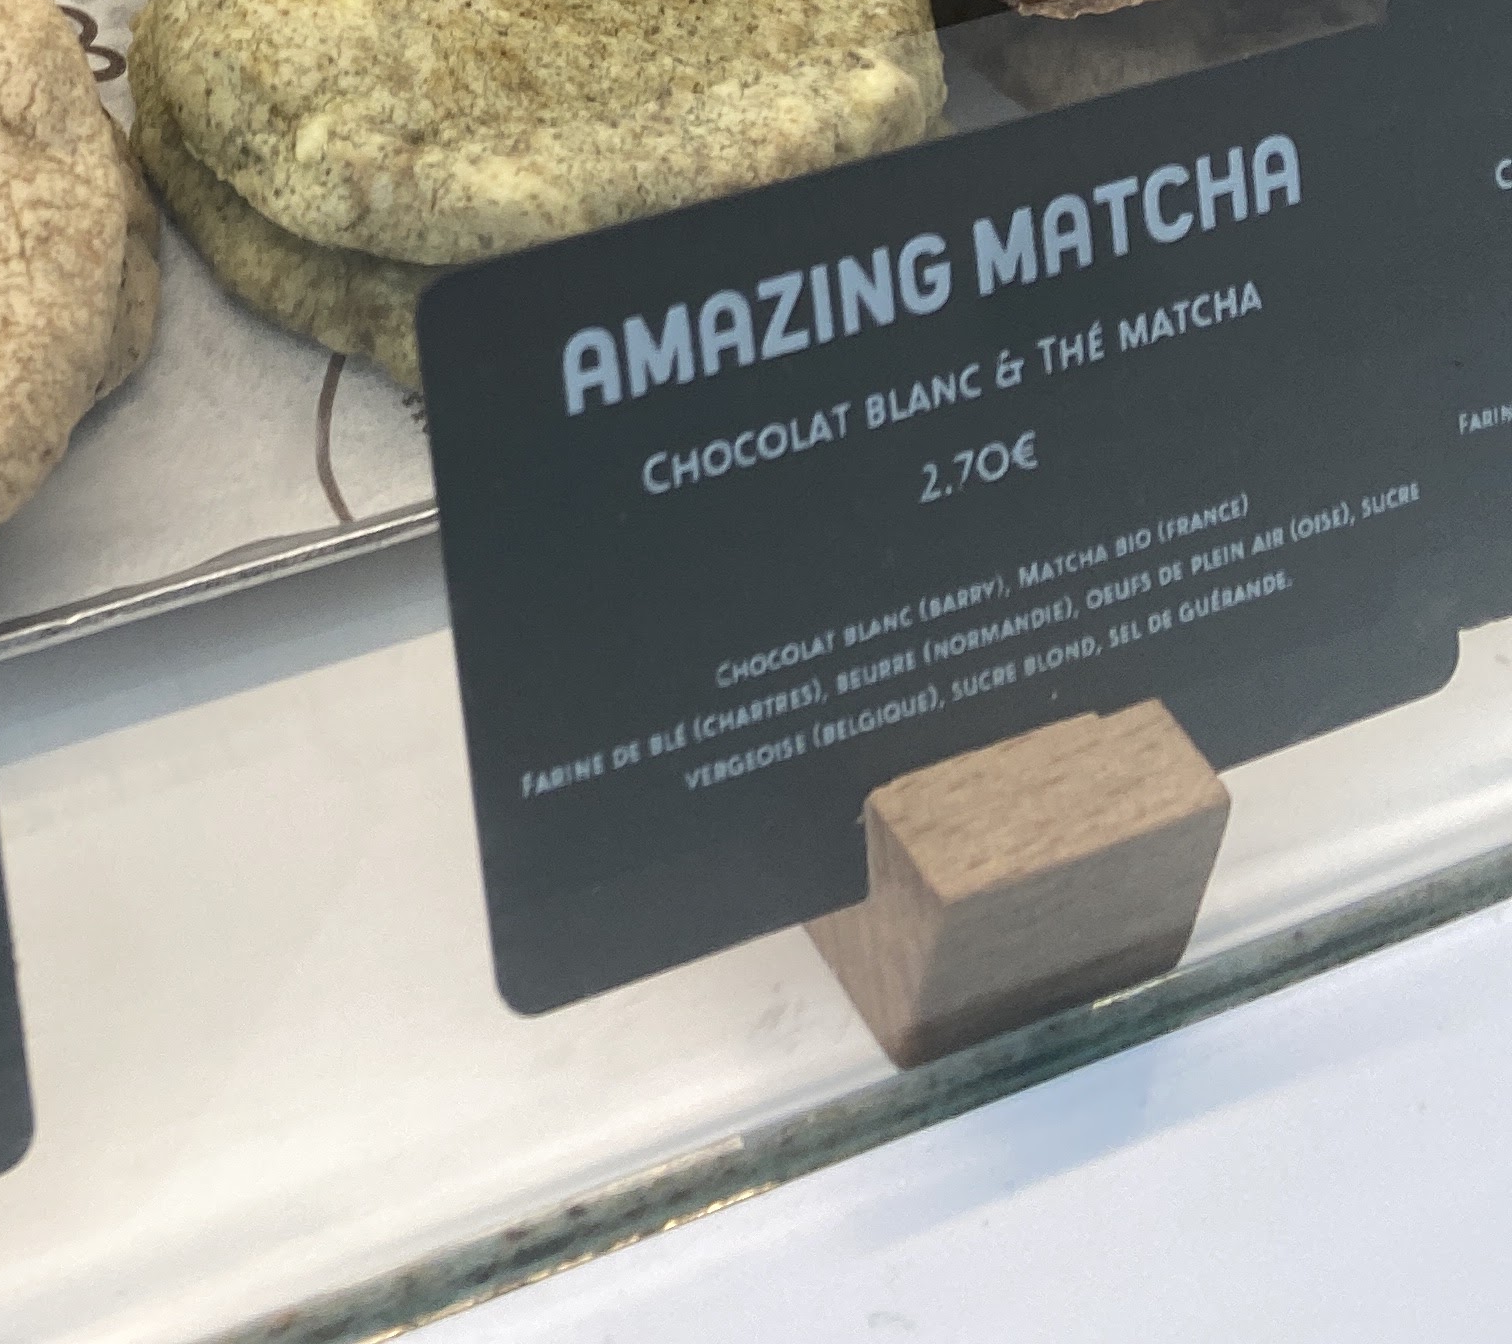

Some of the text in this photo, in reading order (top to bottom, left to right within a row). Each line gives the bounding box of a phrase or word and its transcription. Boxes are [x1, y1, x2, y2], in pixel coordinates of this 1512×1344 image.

[560, 132, 1303, 417] AMAZING MATCHA
[641, 278, 1264, 495] CHOCOLAT BLANC & THÉ MATCHA
[919, 428, 1039, 503] 2.70€
[521, 752, 605, 798] FARINE
[612, 738, 642, 769] DE
[649, 720, 687, 756] BLÉ
[836, 650, 916, 694] BEURRE
[1086, 567, 1152, 611] OEUFS
[1158, 559, 1183, 587] DE
[1190, 538, 1246, 576] PLEIN
[1249, 526, 1285, 556] AIR
[1360, 480, 1421, 519] SUCRE
[715, 629, 838, 689] CHOCOLAT
[843, 604, 914, 648] BLANC
[1018, 542, 1109, 589] MATCHA
[1114, 527, 1151, 559] BIO
[1157, 492, 1249, 543] (FRANCE)
[684, 732, 807, 791] VERGEOISE
[950, 662, 1017, 702] SUCRE
[1108, 620, 1140, 649] SEL
[1148, 608, 1173, 635] DE
